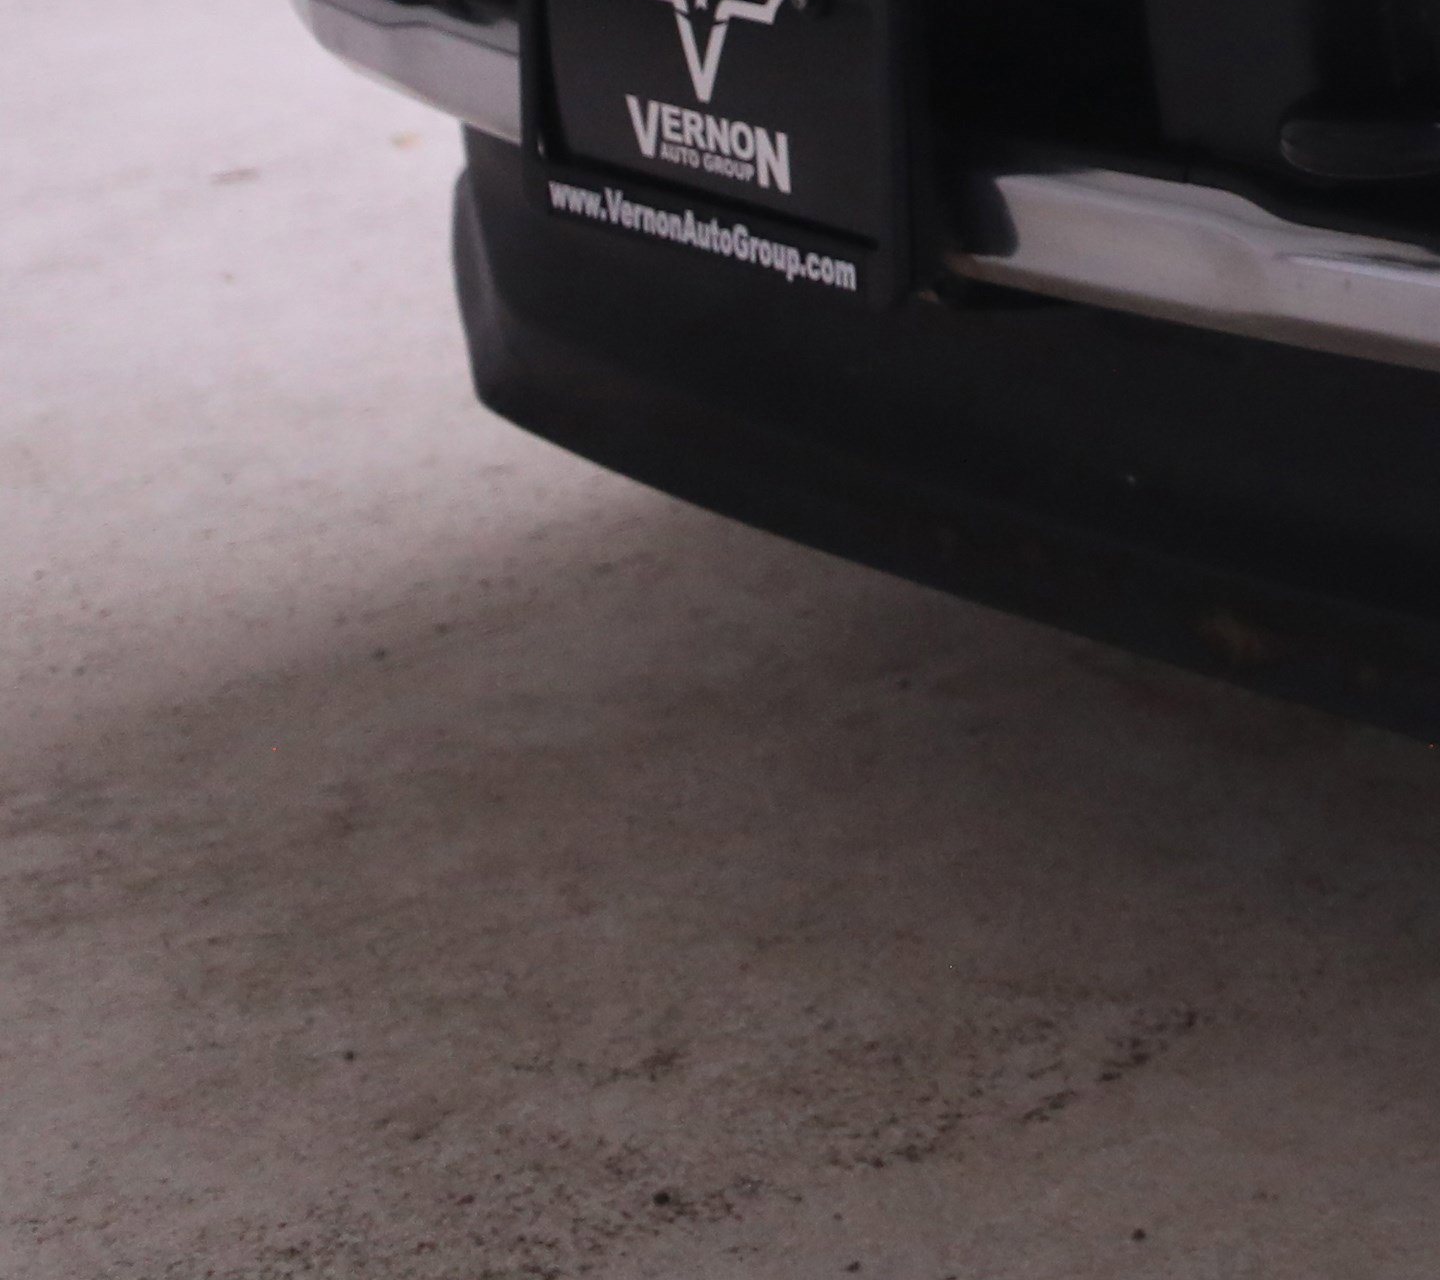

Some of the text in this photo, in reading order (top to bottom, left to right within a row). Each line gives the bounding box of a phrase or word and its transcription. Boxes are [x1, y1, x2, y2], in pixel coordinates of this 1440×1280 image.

[625, 93, 792, 194] VERNON
[660, 141, 756, 181] AUTO GROUP
[547, 180, 859, 292] www.VernonAutoGroup.com
